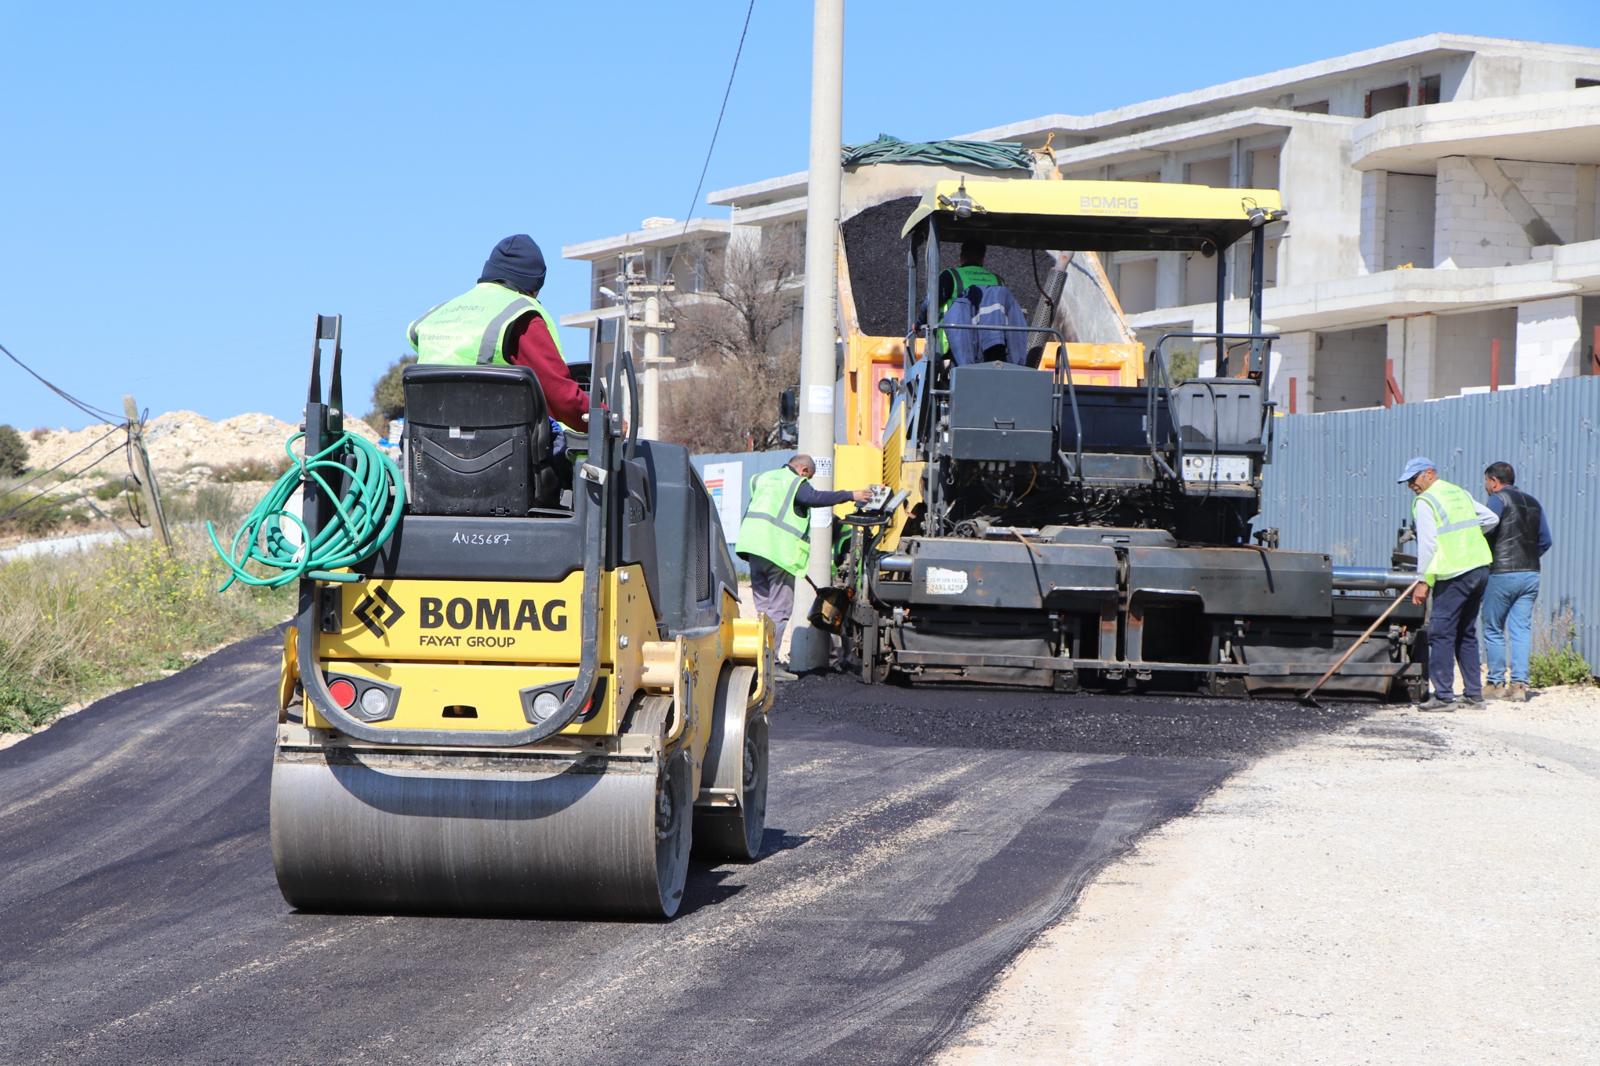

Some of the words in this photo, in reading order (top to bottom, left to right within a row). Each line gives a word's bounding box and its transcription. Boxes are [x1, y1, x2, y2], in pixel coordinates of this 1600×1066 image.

[1080, 196, 1138, 209] BOMAG
[452, 532, 512, 545] AN25687
[419, 597, 567, 631] BOMAG
[419, 636, 462, 647] FAYAT
[466, 636, 516, 648] GROUP
